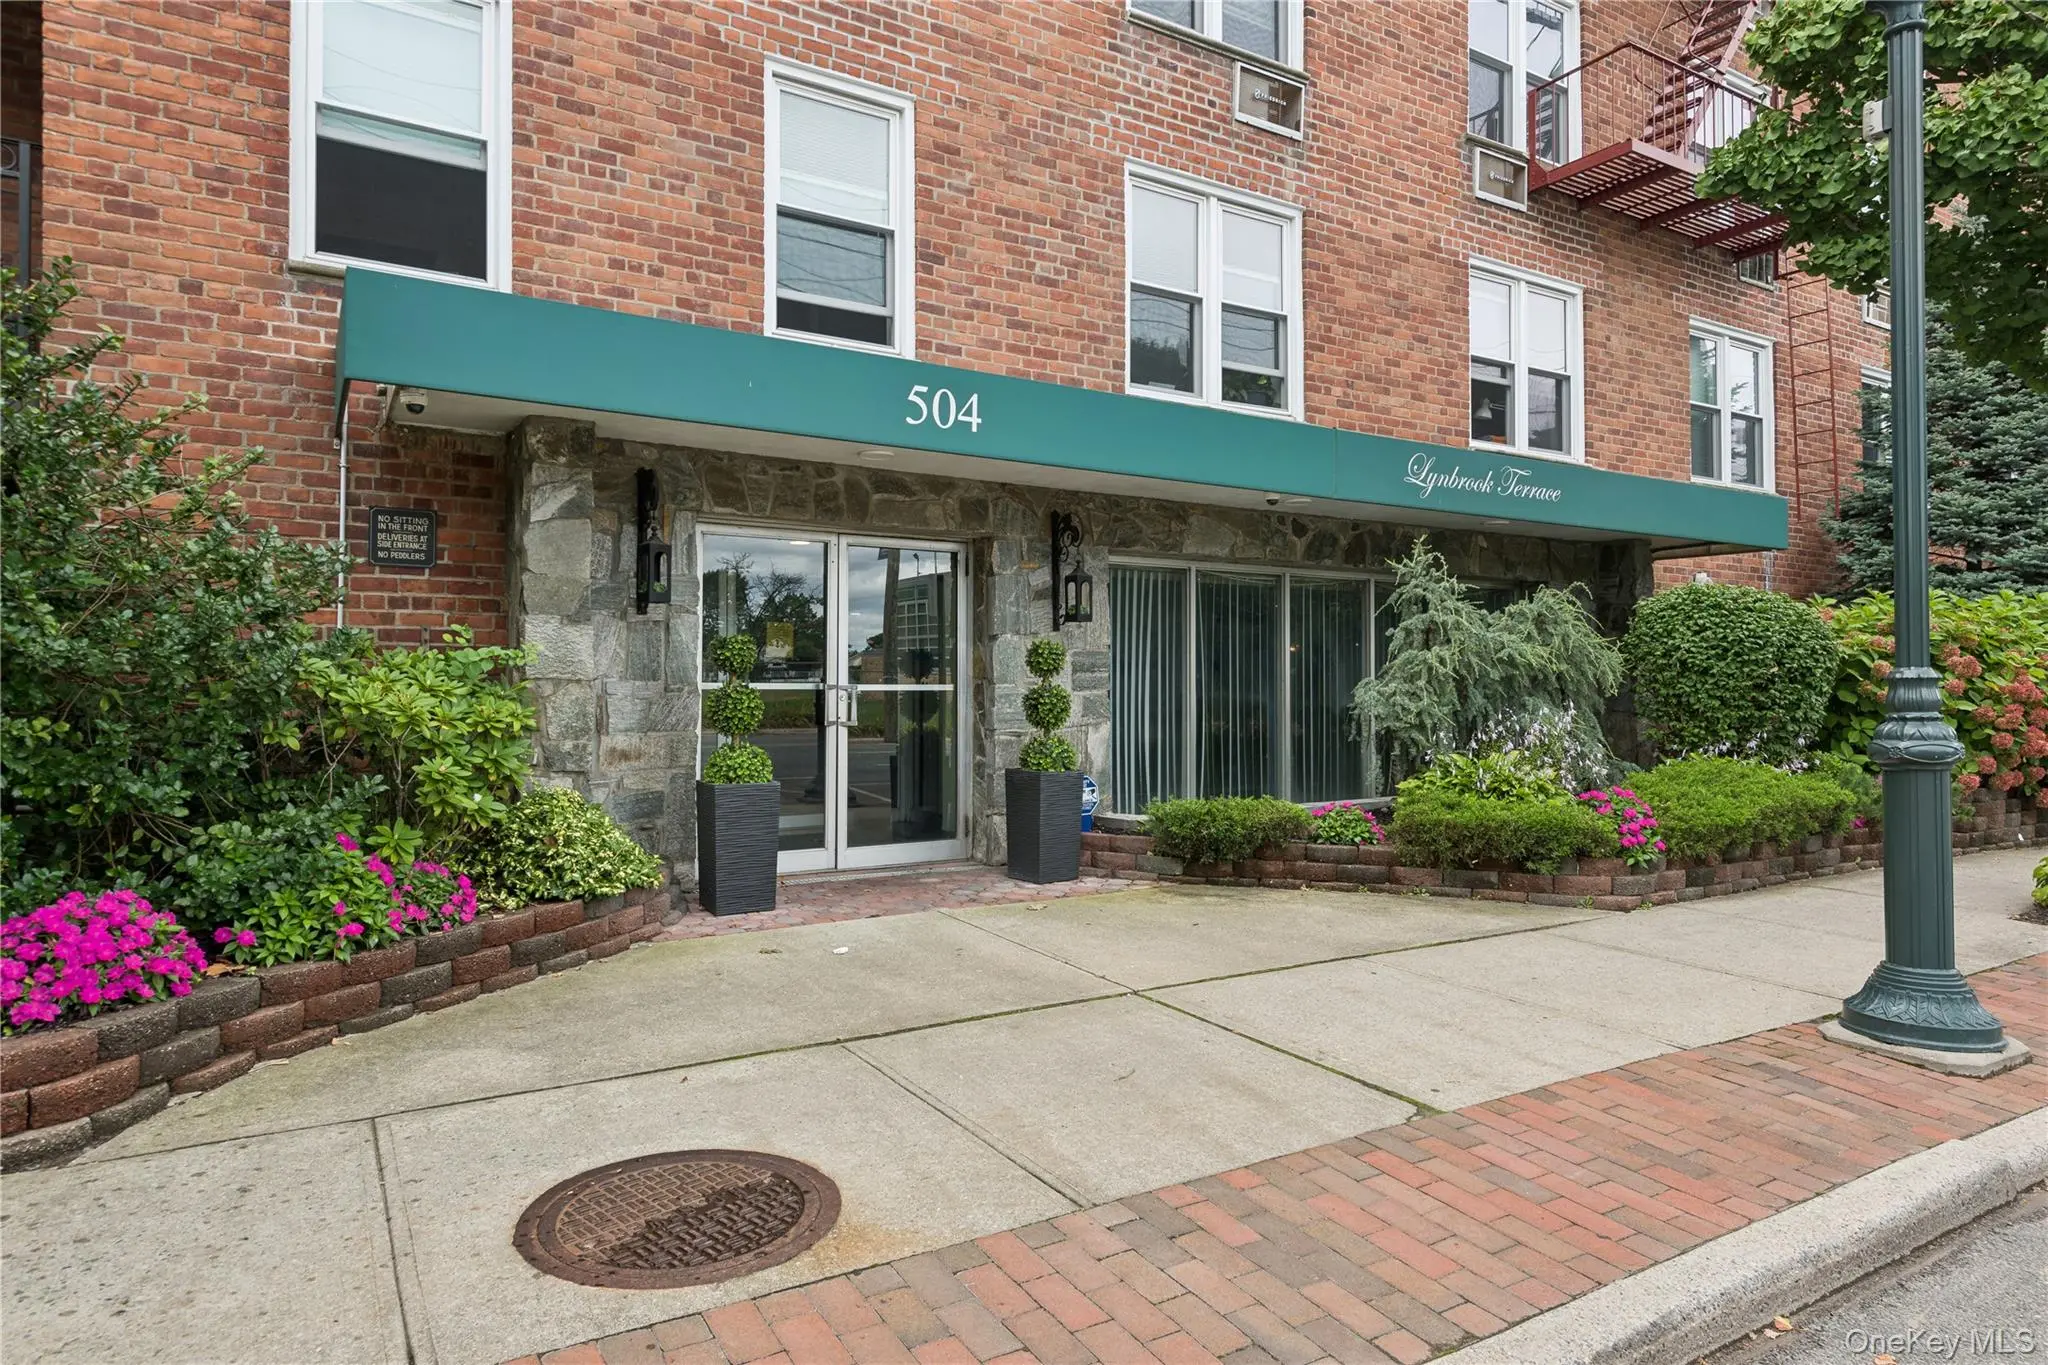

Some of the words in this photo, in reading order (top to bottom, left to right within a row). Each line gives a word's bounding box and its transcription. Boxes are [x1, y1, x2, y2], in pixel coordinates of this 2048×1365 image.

[905, 385, 982, 433] 504
[1404, 452, 1494, 499] Lynbrook
[1498, 465, 1562, 502] Terrace
[393, 516, 428, 525] SITTING
[377, 533, 418, 542] DELIVERIES
[393, 542, 427, 550] ENTRANCE
[391, 552, 425, 560] PEDDLERS
